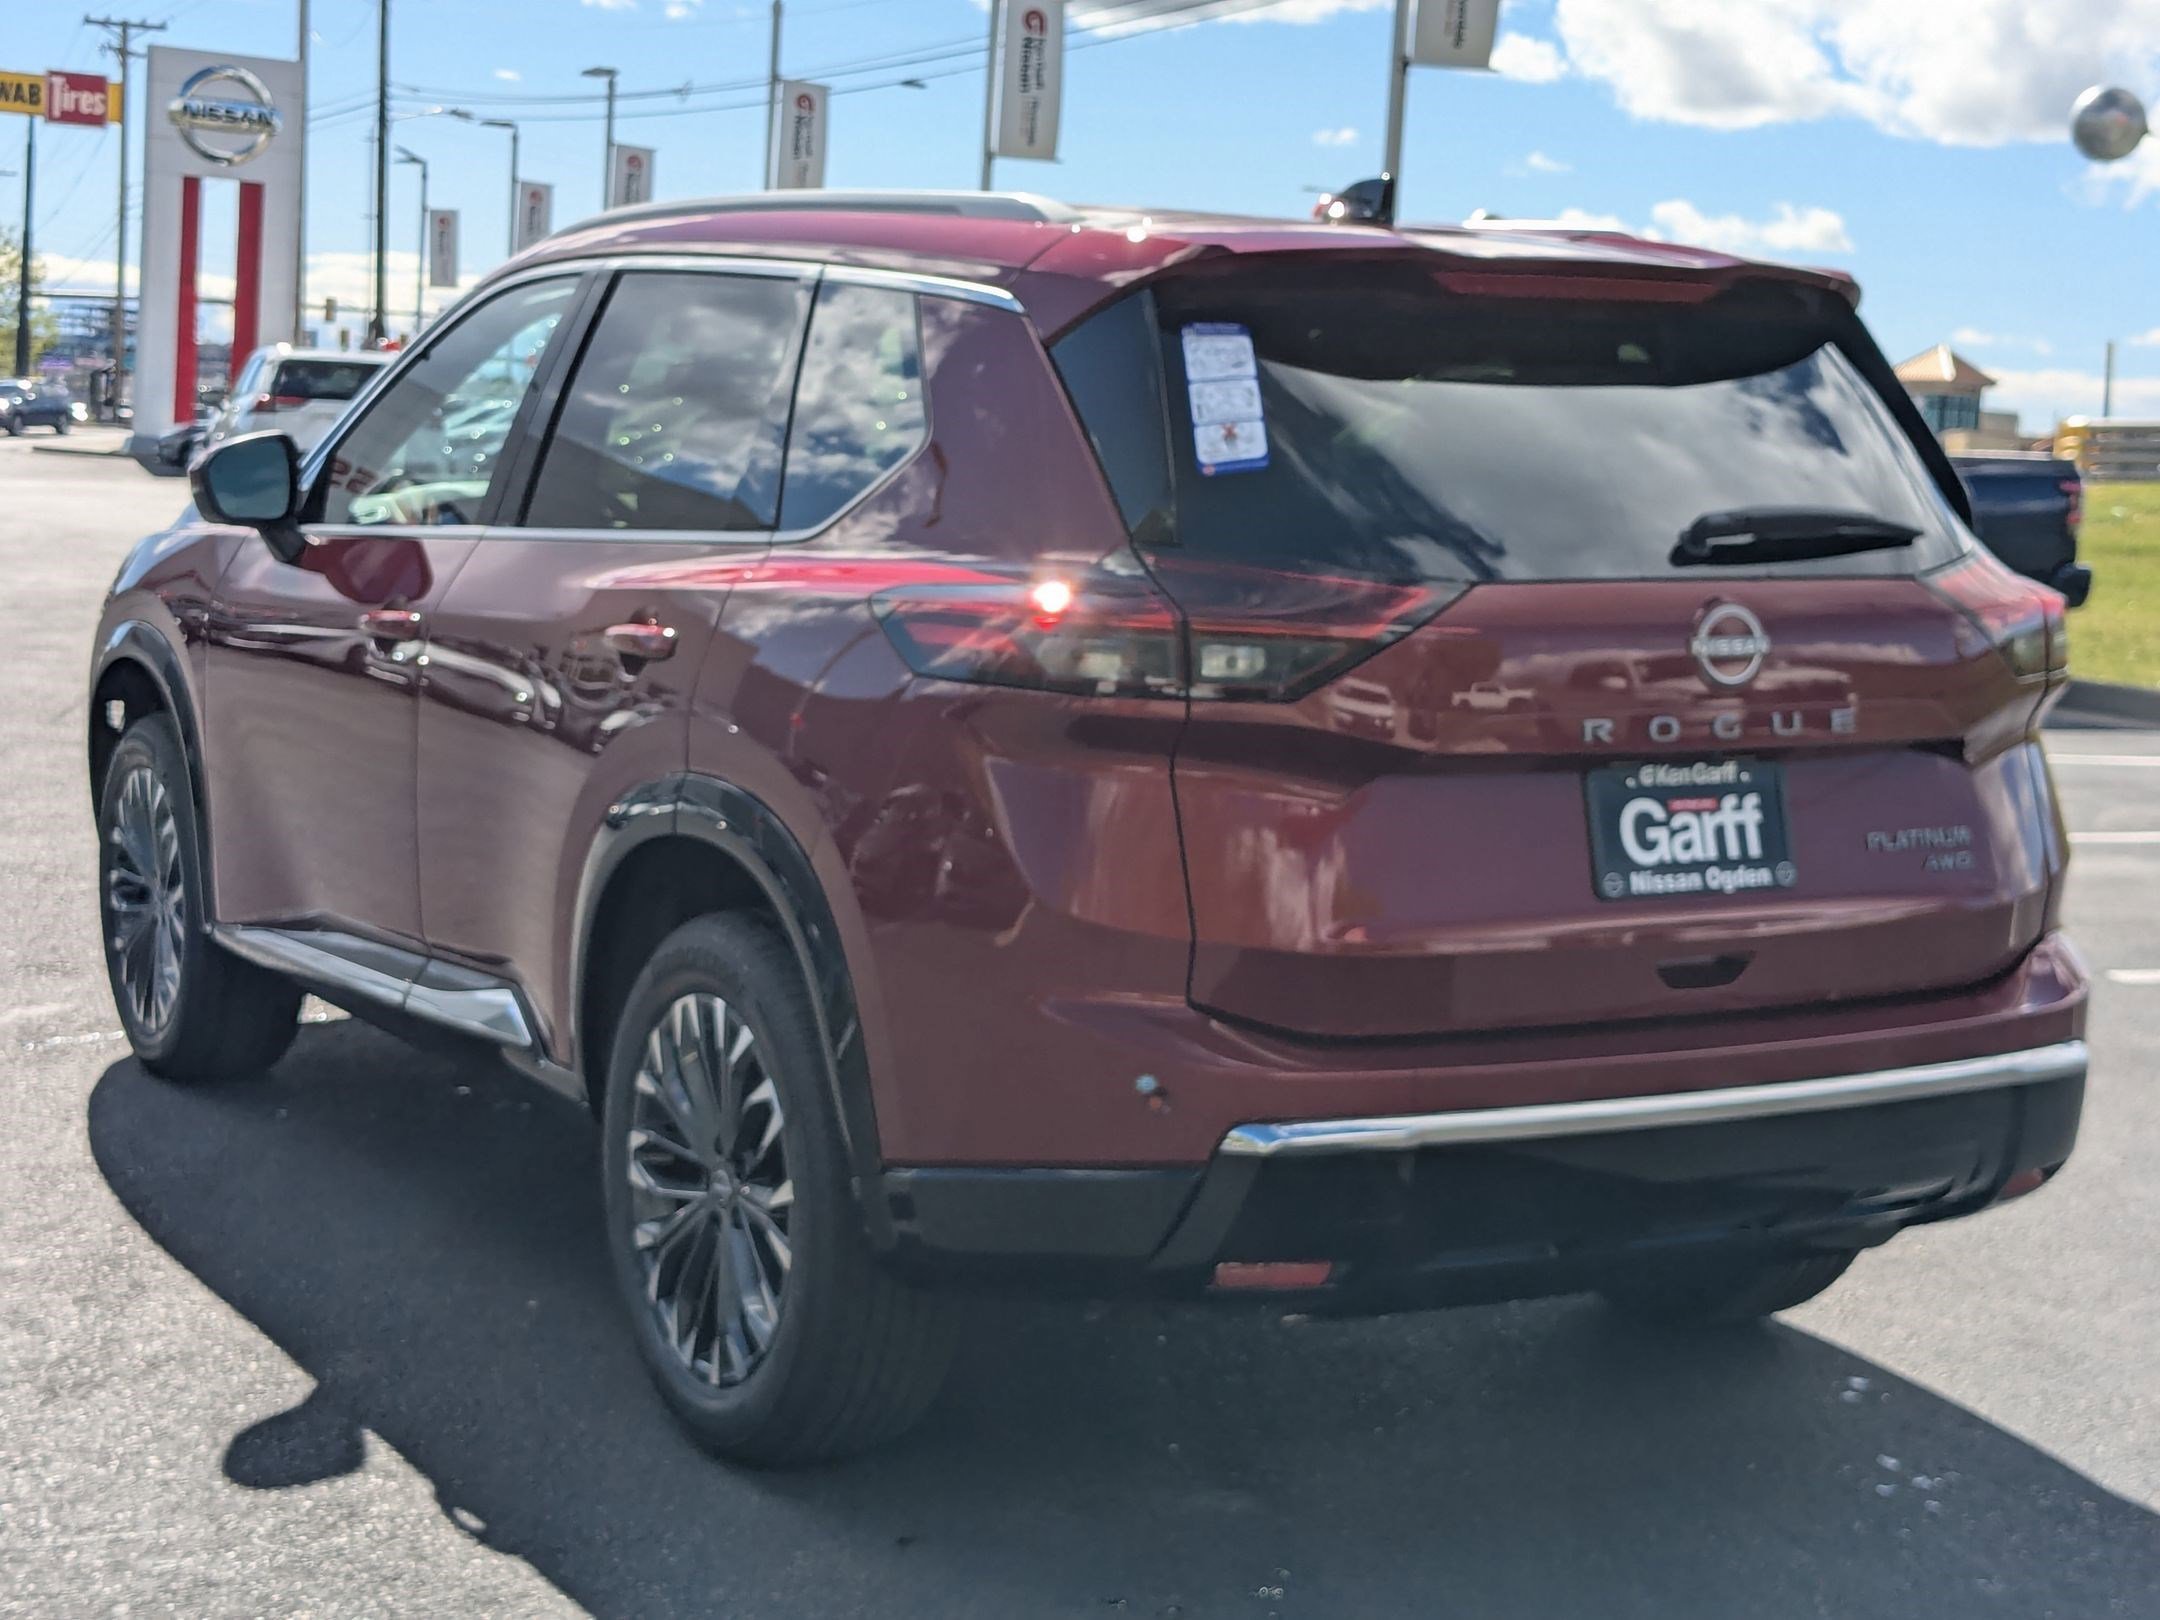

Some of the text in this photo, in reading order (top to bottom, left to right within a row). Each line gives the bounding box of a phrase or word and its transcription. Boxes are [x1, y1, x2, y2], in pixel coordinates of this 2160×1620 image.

[51, 76, 106, 119] Tires
[182, 102, 274, 126] NISSAN
[1583, 707, 1856, 743] ROGUE
[1619, 792, 1763, 867] Garff
[1866, 825, 1971, 852] PLATINUM
[1923, 850, 1973, 870] AWD
[1629, 864, 1773, 895] Nissan Ogden
